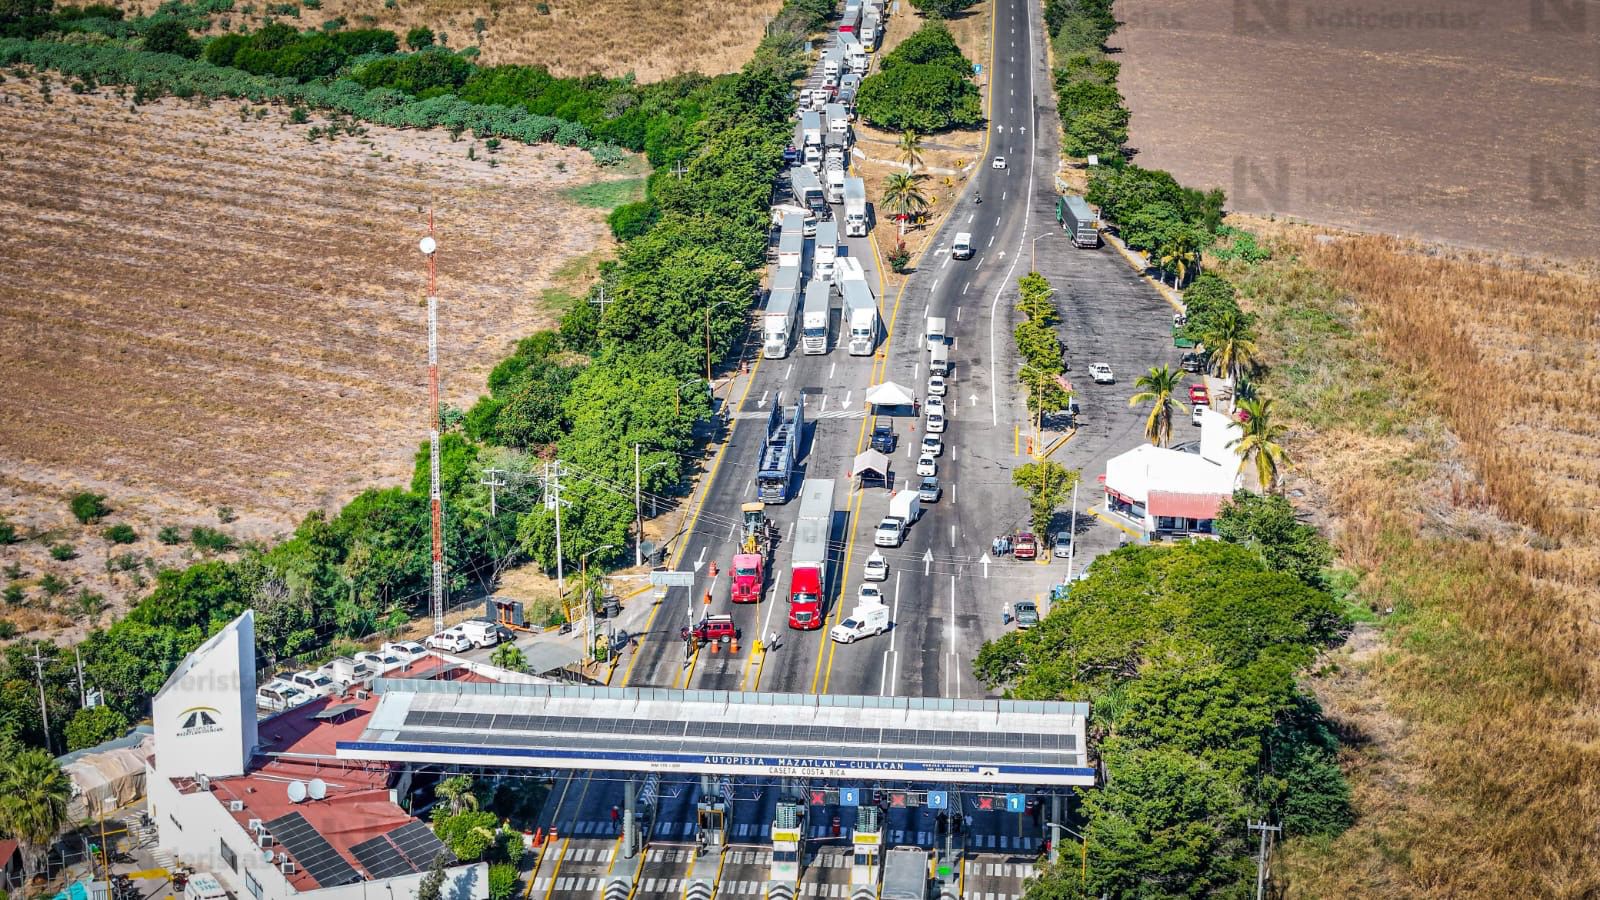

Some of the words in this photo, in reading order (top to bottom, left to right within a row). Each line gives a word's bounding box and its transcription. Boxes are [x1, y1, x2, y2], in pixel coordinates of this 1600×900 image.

[704, 755, 764, 766] AUTOPISTA
[778, 758, 836, 768] MAZATLAN
[850, 760, 904, 770] CULIACAN
[769, 767, 797, 775] CASETA
[802, 768, 825, 776] COSTA
